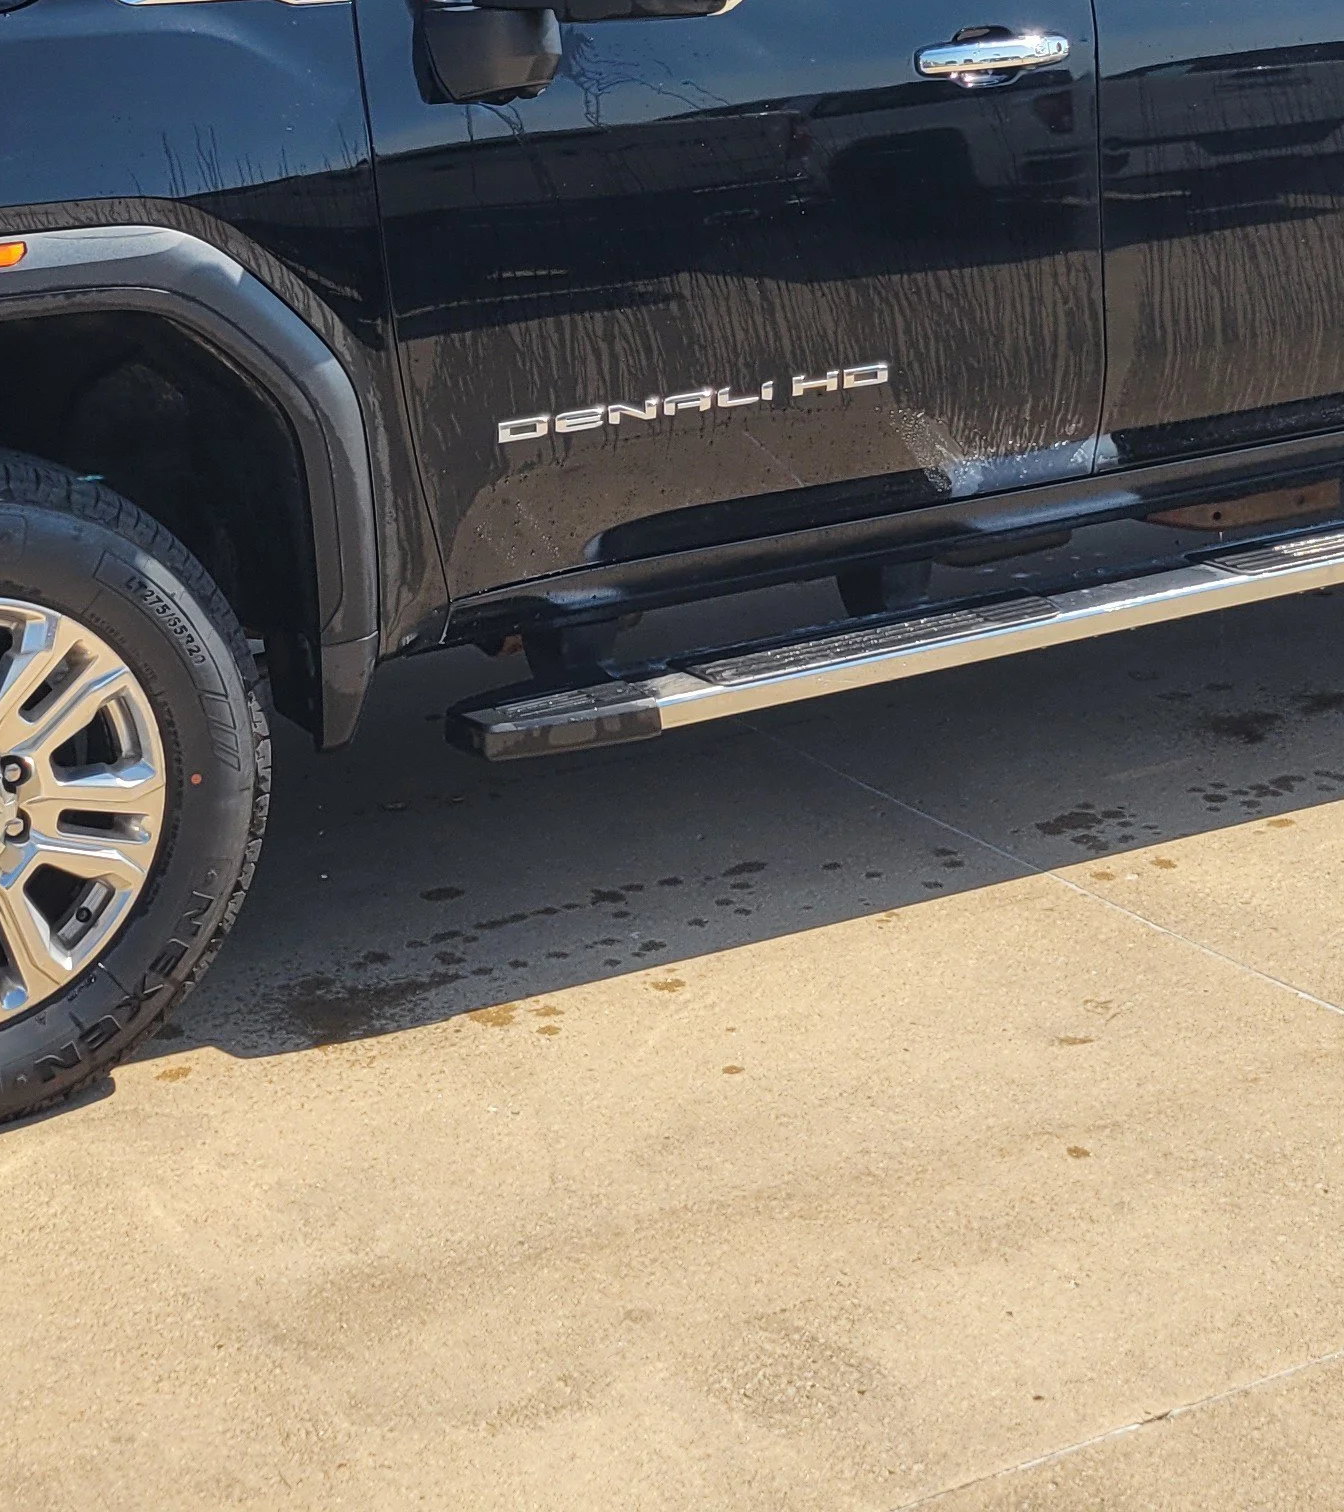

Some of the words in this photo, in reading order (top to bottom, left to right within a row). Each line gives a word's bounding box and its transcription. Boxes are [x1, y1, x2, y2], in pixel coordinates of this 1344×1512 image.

[498, 380, 774, 443] DENALI
[792, 361, 890, 397] HD
[125, 574, 207, 667] LT275/65R20
